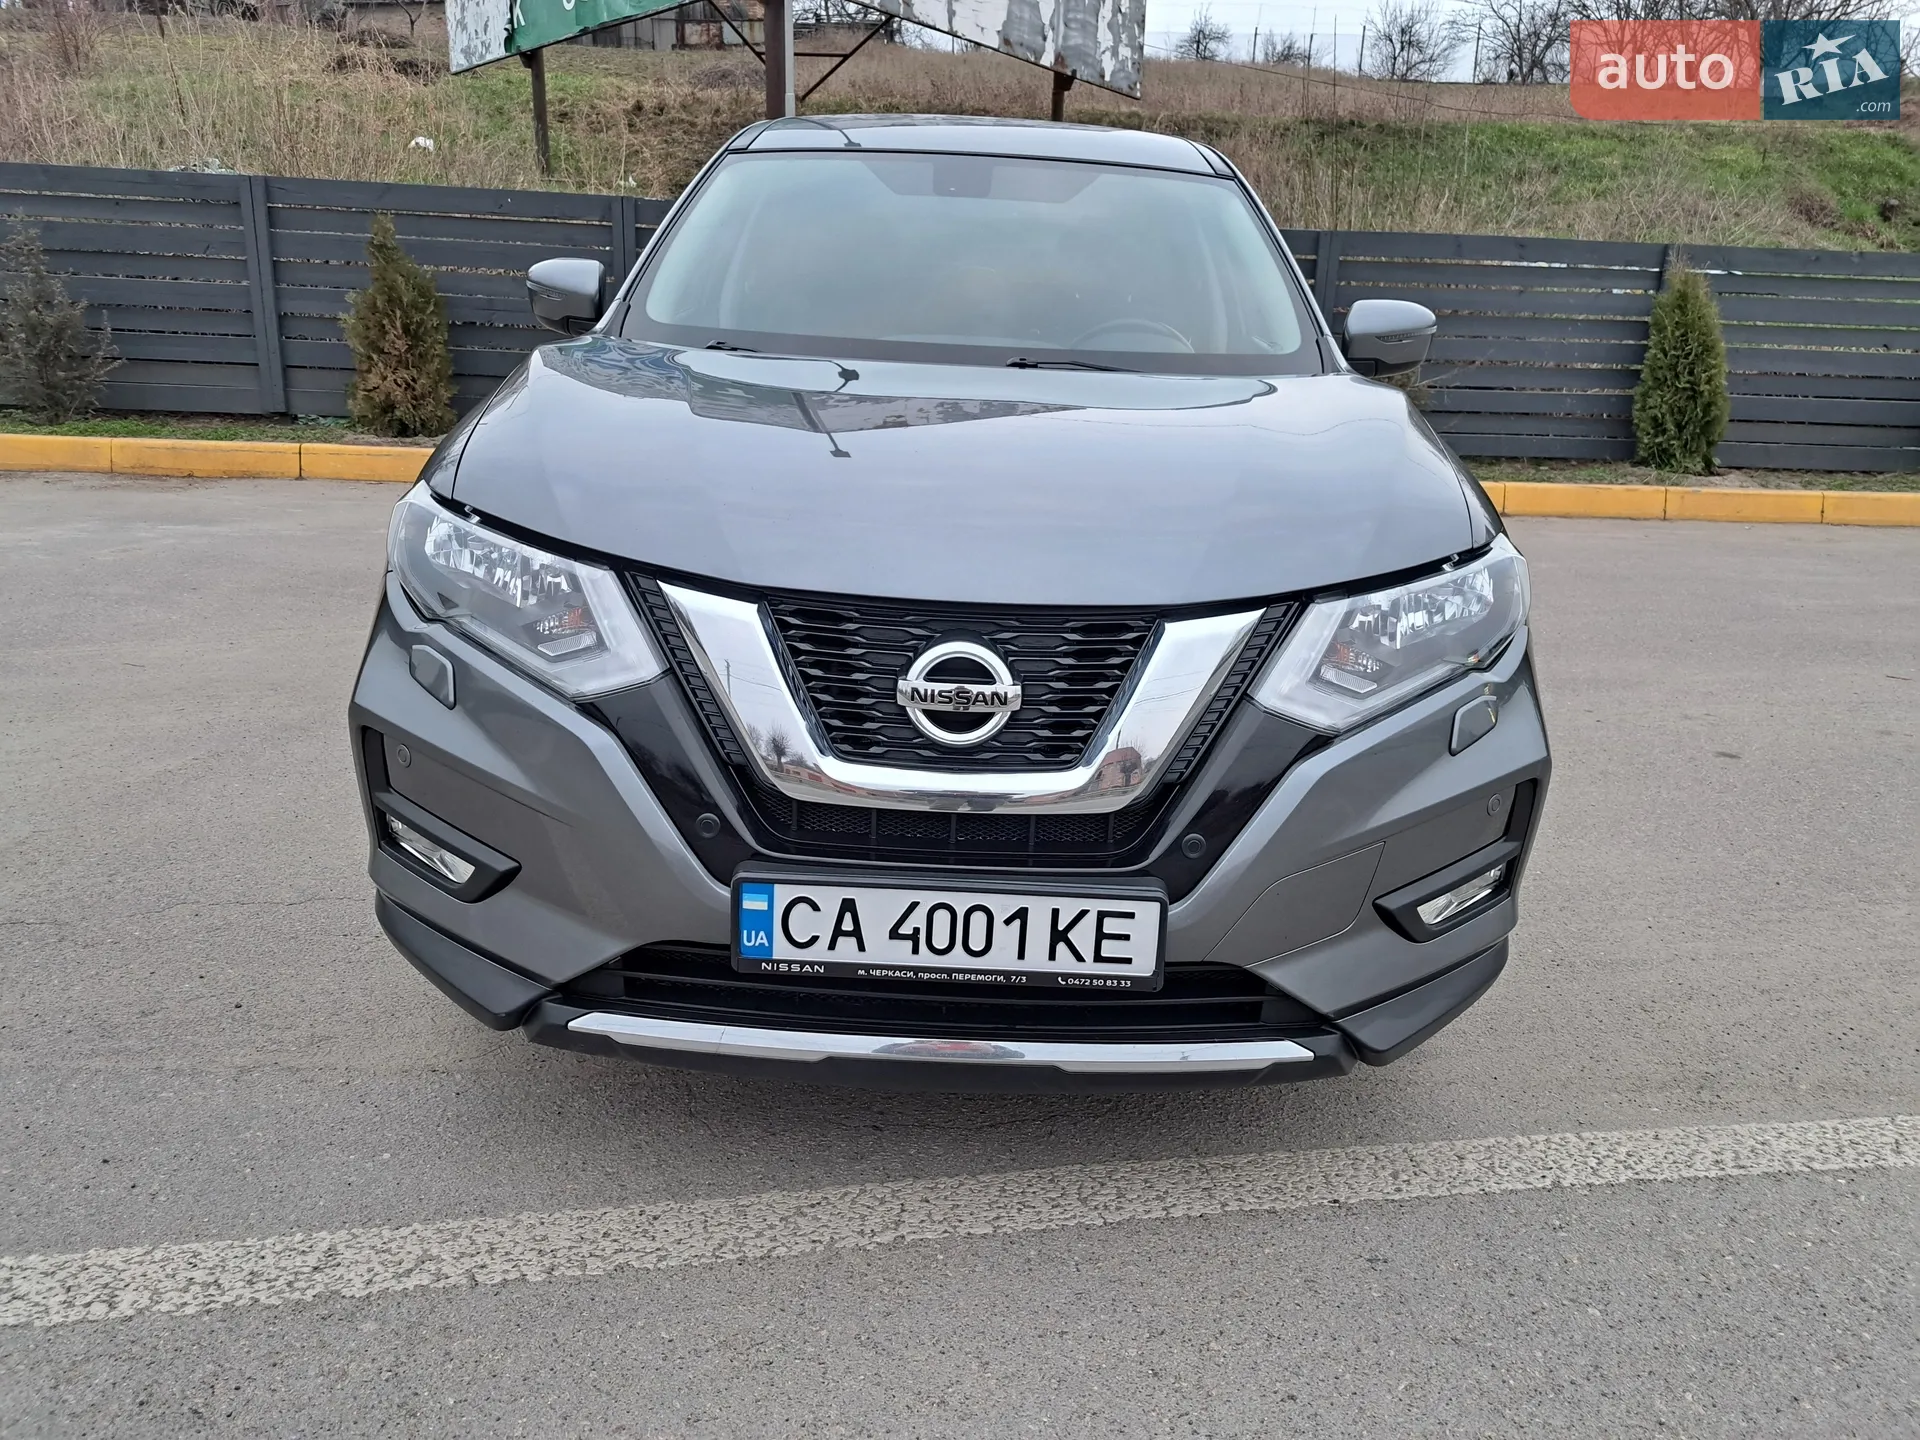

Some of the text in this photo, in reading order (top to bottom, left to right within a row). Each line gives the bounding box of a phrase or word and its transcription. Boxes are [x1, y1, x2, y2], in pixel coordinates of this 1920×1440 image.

[910, 686, 1008, 706] NISSAN
[743, 929, 769, 947] UA
[781, 895, 1136, 965] CA 4001 KE
[761, 962, 825, 973] NISSAN
[869, 969, 916, 979] ЧЕРКАСИ,
[918, 972, 950, 980] просп.
[952, 973, 1006, 983] ПЕРЕМОГИ,
[1010, 975, 1027, 984] 7/3
[1067, 978, 1091, 986] 0472
[1092, 979, 1105, 987] 50
[1119, 980, 1132, 988] 33
